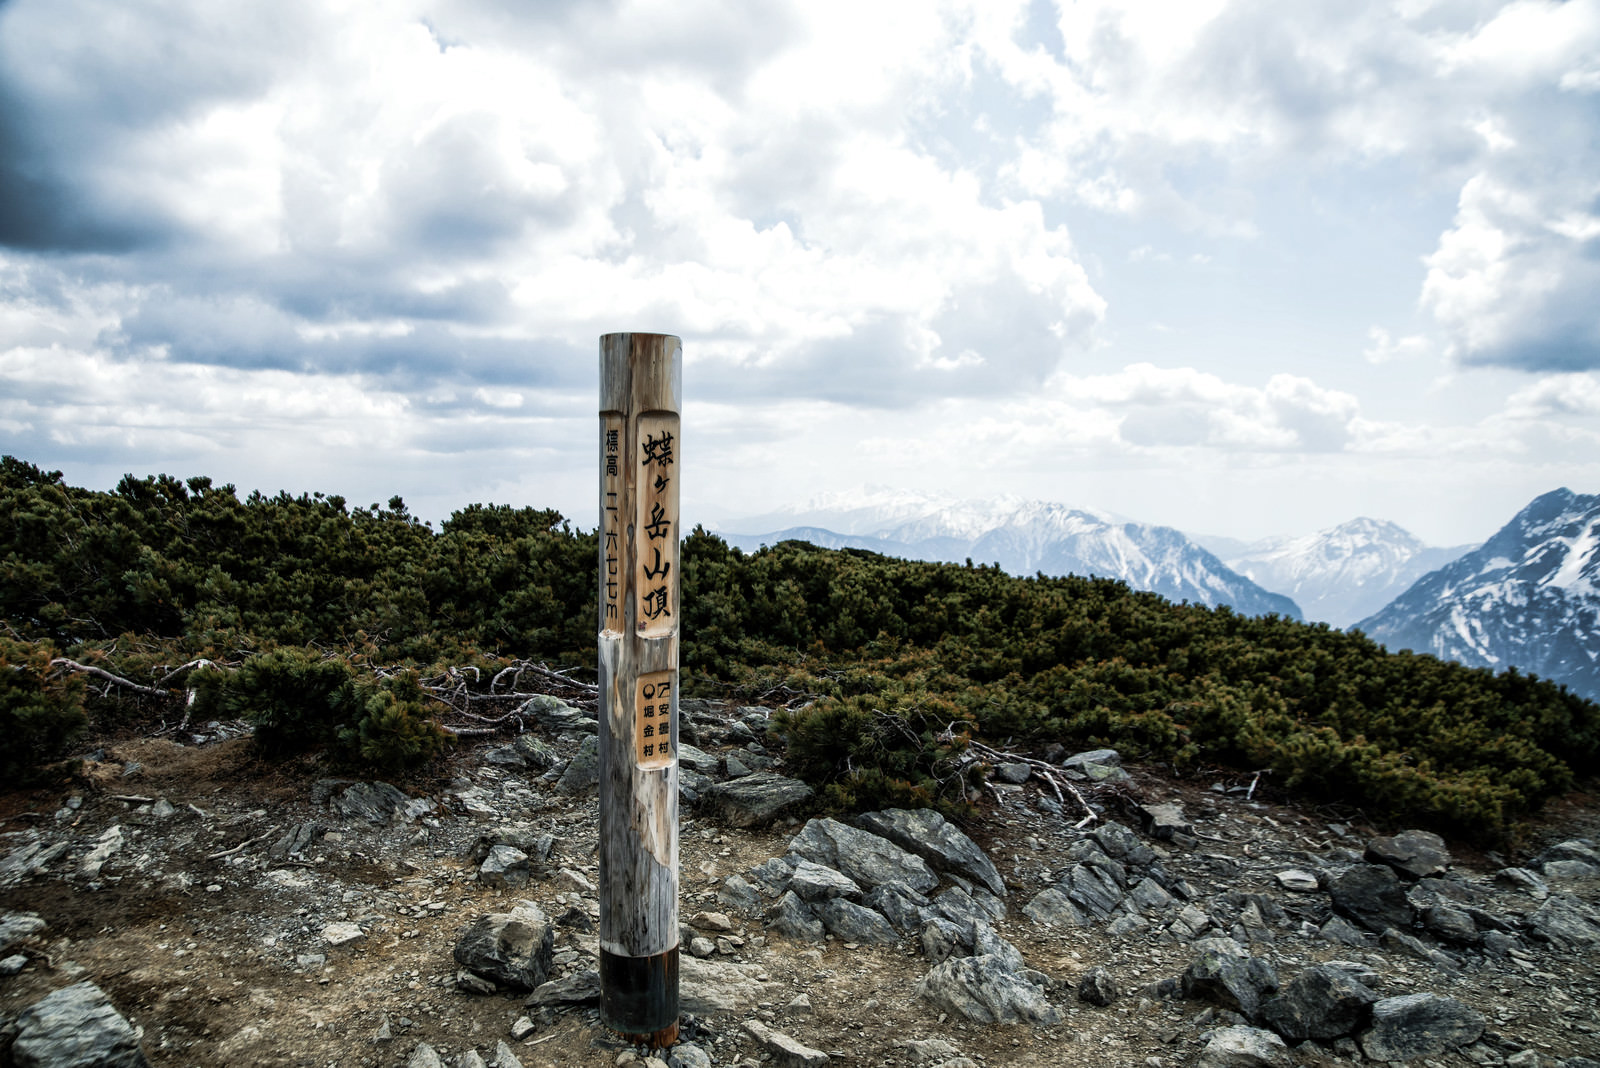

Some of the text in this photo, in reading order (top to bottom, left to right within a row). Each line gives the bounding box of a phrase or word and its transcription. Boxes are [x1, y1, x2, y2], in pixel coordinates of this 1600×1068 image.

[606, 430, 618, 476] 標高
[643, 706, 655, 757] 堀金村
